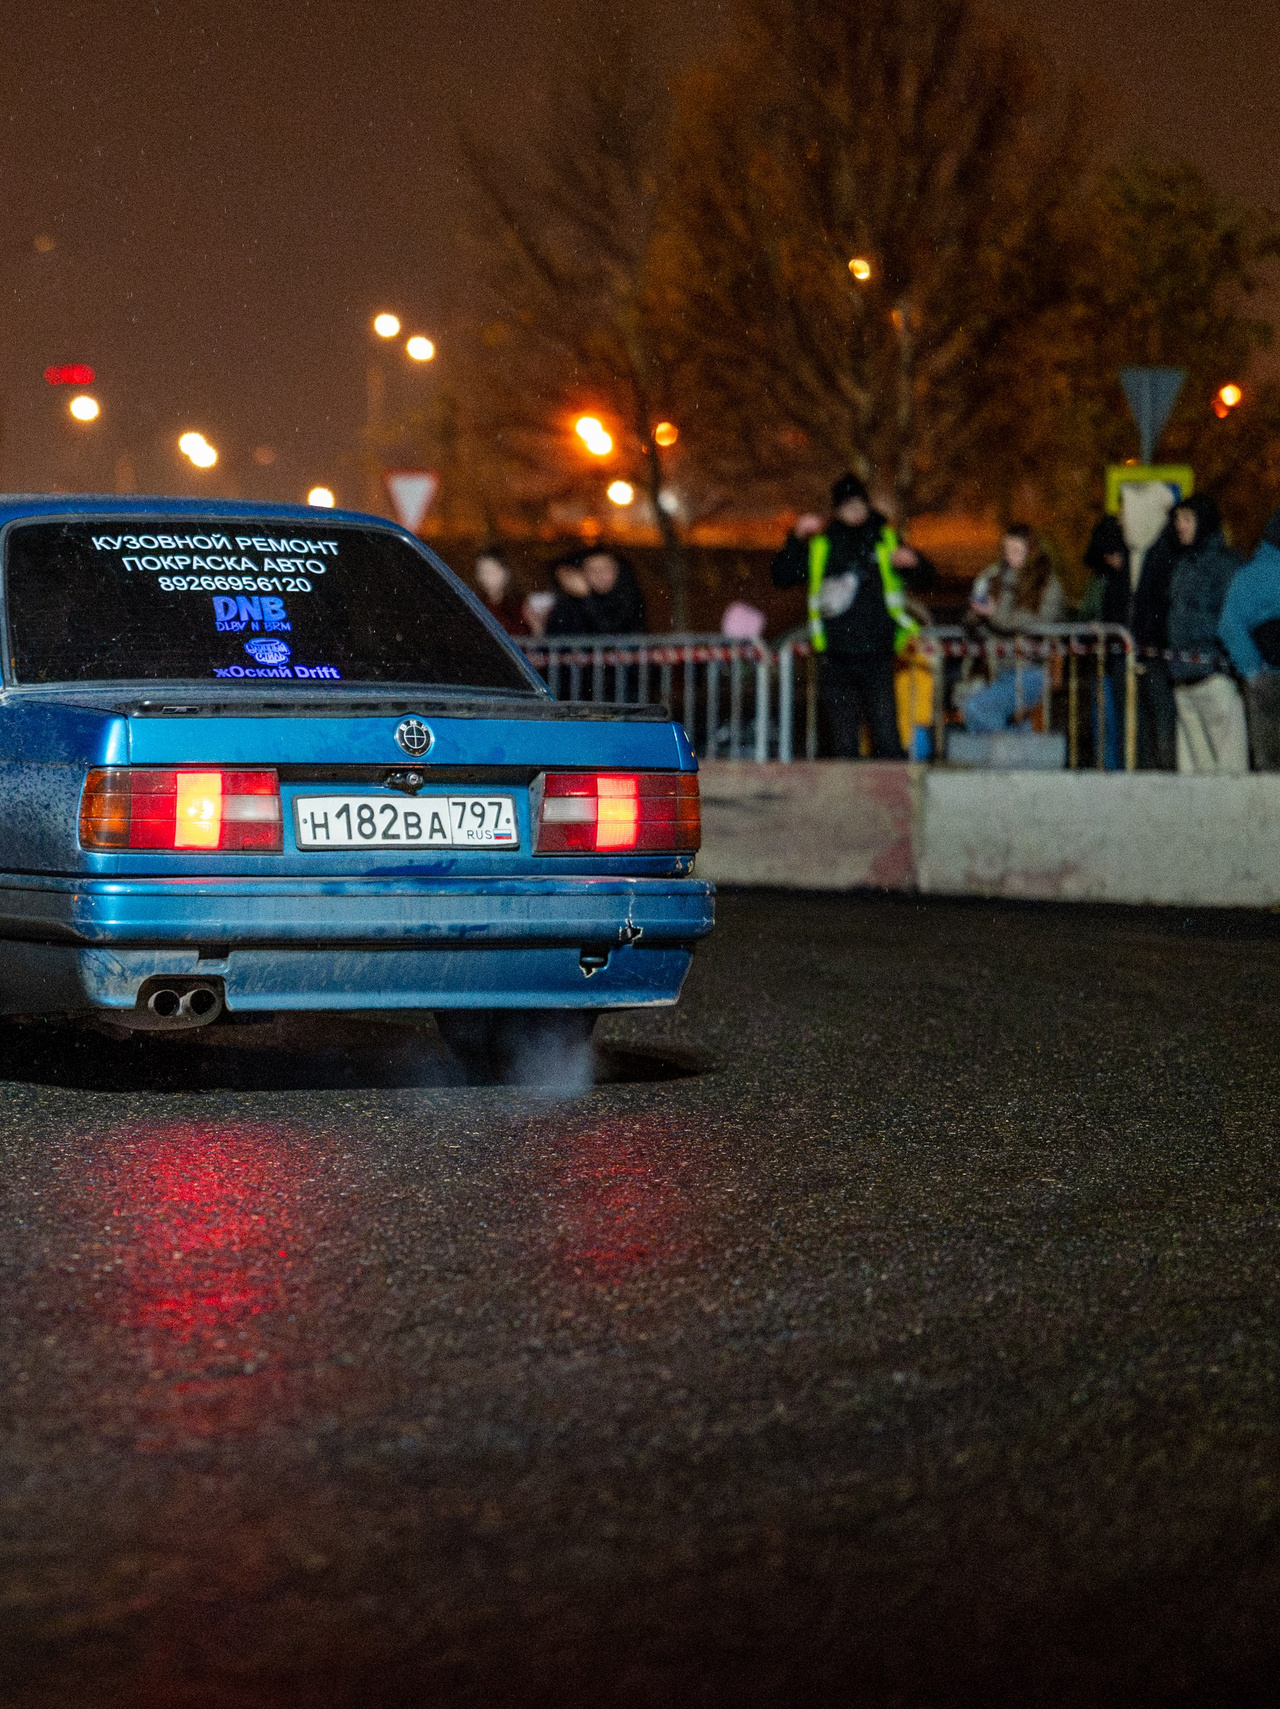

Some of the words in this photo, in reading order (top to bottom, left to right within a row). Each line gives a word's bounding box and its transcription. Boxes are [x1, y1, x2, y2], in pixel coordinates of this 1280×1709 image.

[91, 534, 233, 551] КУЗОВНОЙ
[234, 537, 339, 556] РЕМОНТ
[121, 556, 260, 572] ПОКРАСКА
[263, 556, 328, 574] АВТО
[158, 576, 312, 592] 89266956120
[211, 596, 288, 622] DNB
[294, 666, 340, 679] Drift
[399, 720, 428, 731] BMW
[451, 801, 503, 829] 797
[467, 830, 492, 839] RUS
